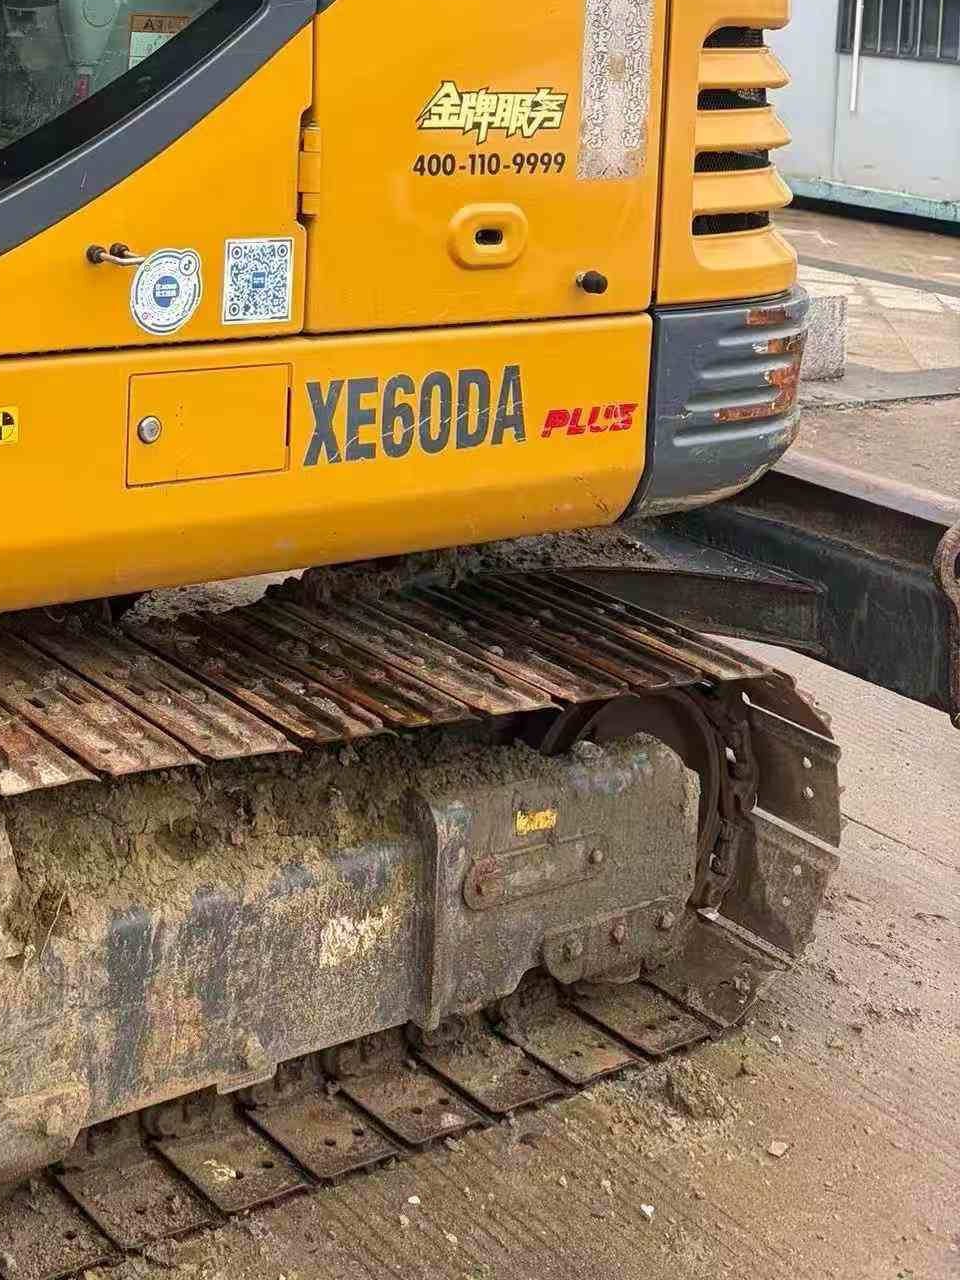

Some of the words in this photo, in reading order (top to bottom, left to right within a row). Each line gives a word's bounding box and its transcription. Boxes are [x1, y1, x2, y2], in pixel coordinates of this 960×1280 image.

[416, 81, 568, 145] 金牌服务
[413, 152, 566, 176] 400-110-9999
[303, 365, 526, 466] XE60DA
[540, 403, 640, 438] PLUS
